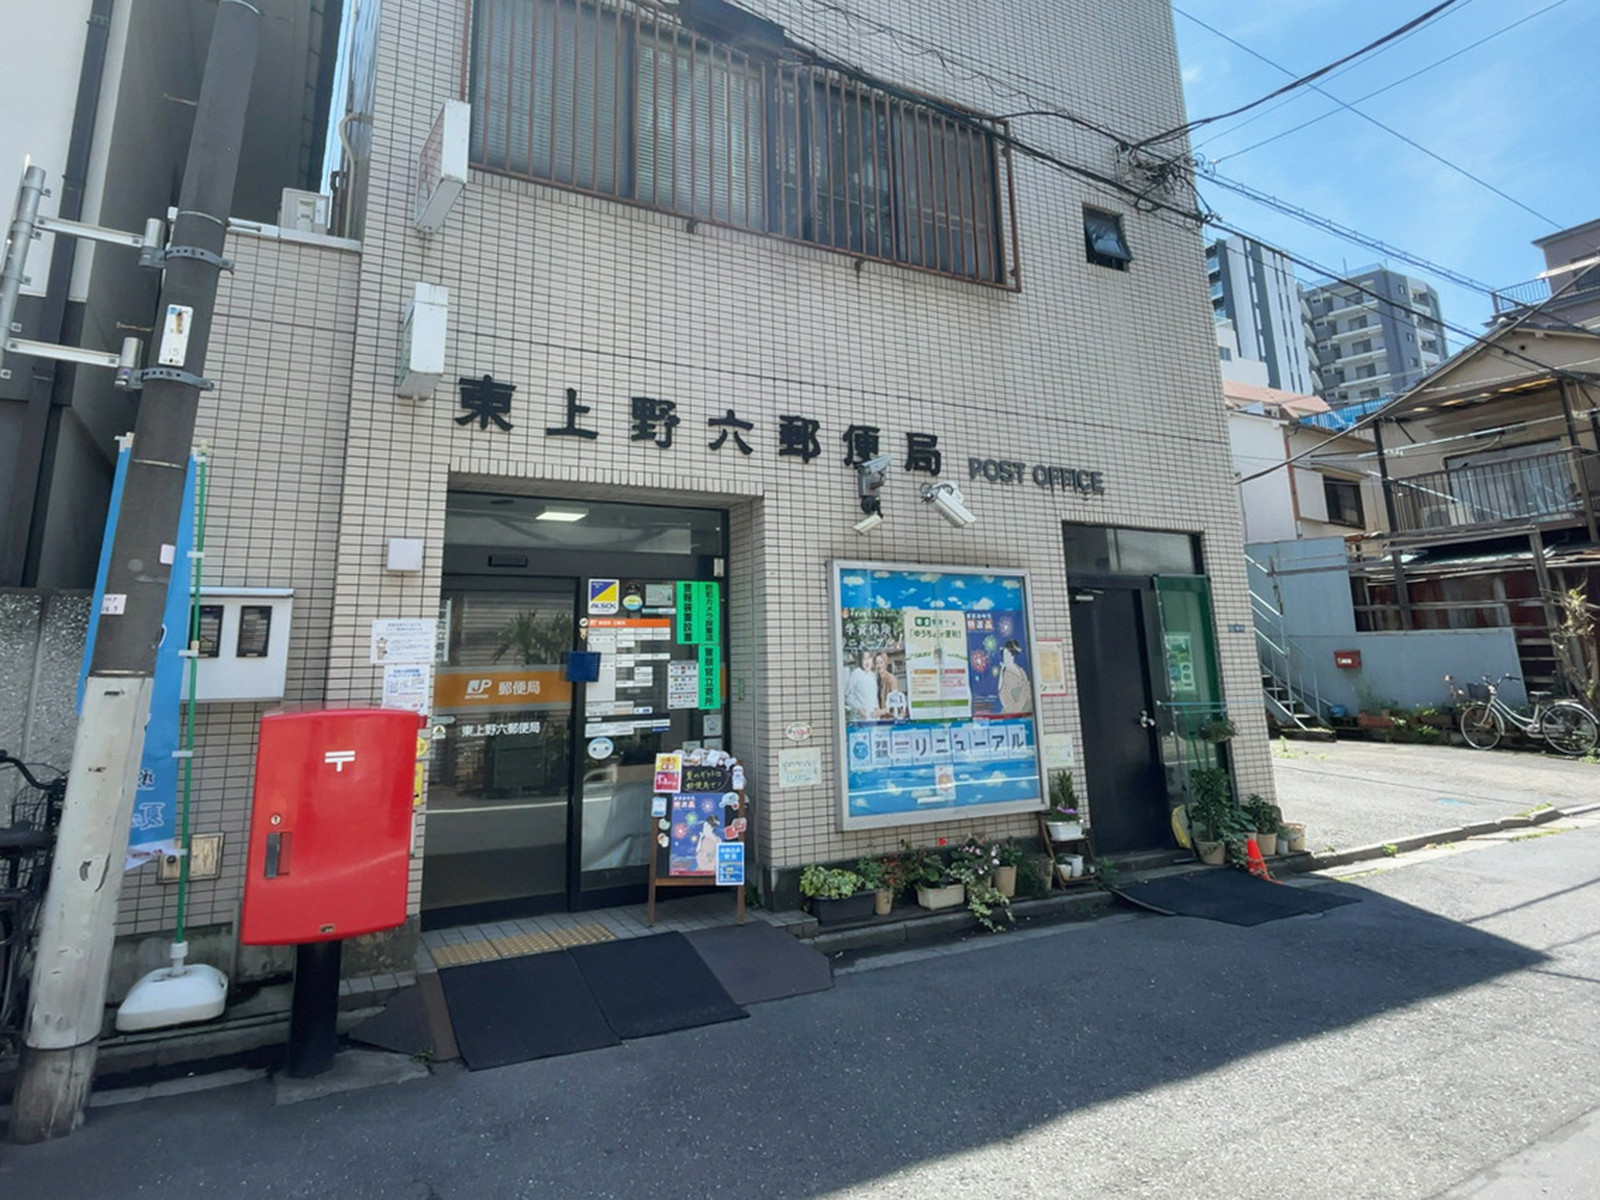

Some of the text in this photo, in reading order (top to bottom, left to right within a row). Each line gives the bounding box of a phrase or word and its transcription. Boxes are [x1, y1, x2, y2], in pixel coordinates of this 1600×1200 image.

[455, 374, 942, 476] 東上野六郵便局
[968, 456, 1106, 496] POST OFFICE
[498, 680, 541, 695] 郵便局
[461, 721, 540, 737] 東上野六郵便局
